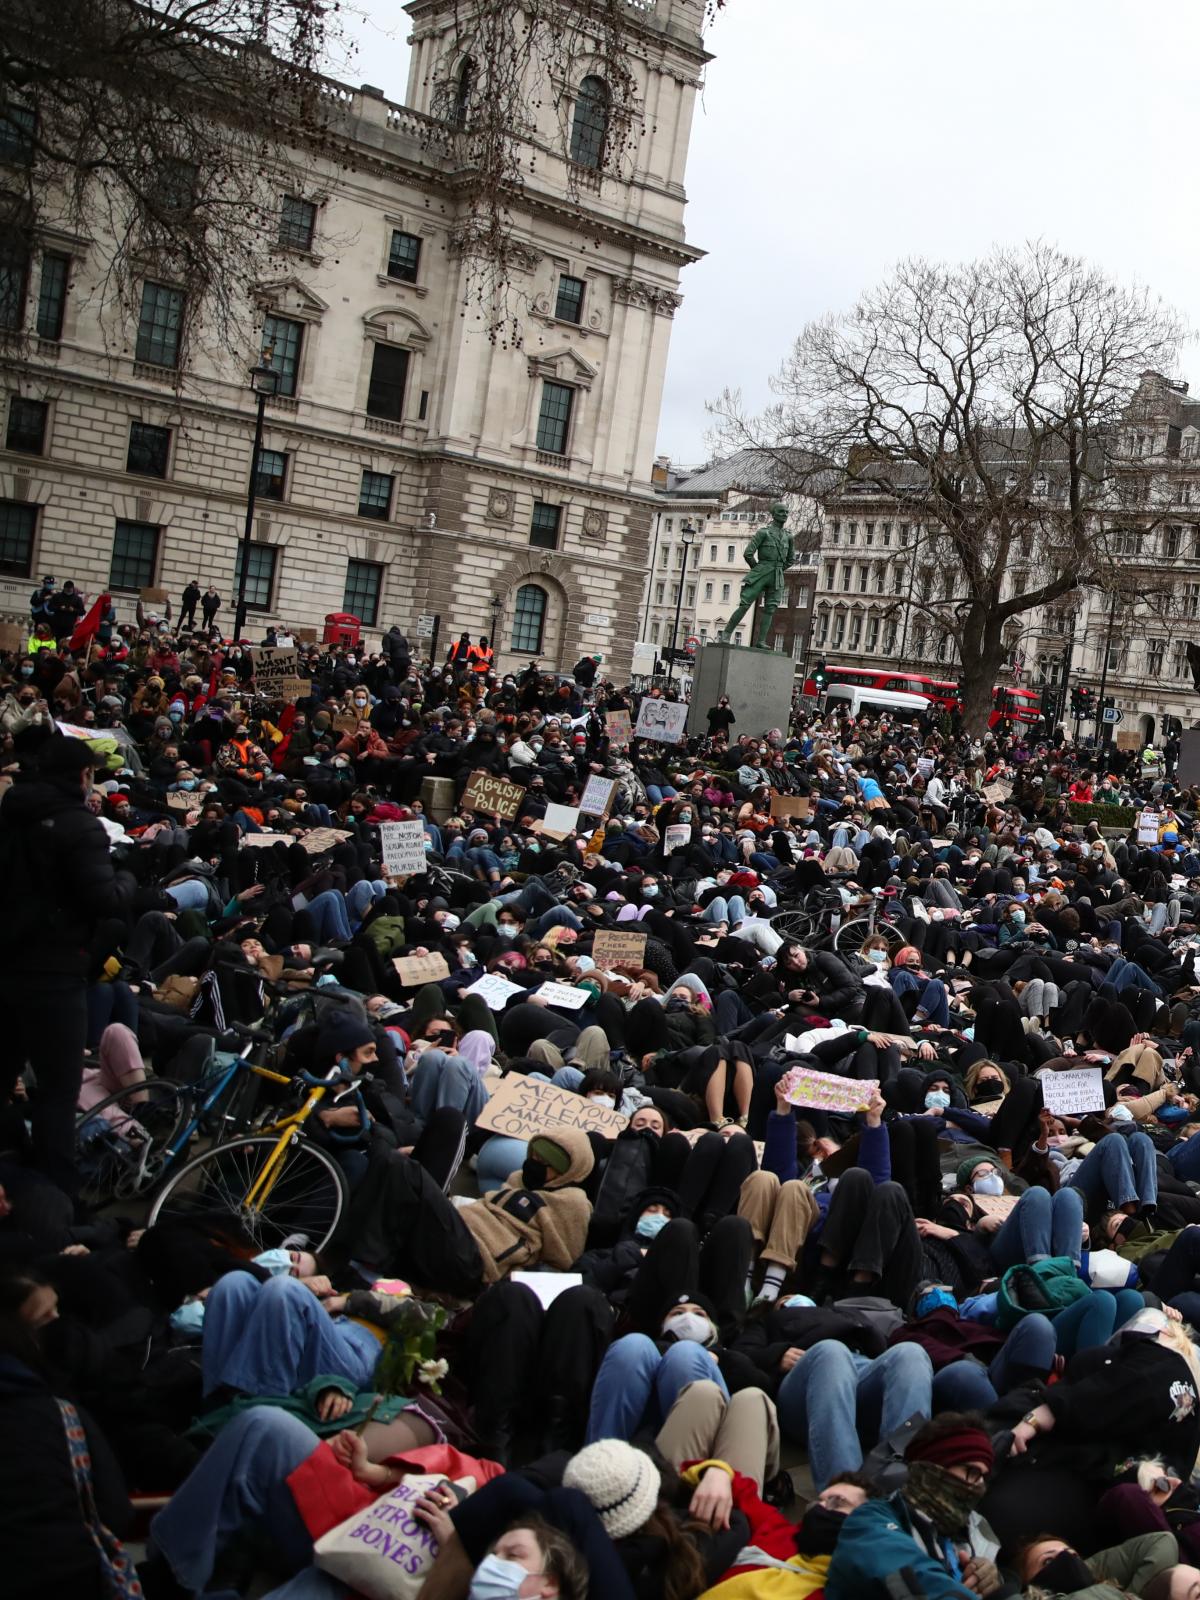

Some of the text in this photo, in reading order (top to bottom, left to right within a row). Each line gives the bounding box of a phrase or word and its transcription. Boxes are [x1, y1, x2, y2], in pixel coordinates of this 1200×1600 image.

[259, 650, 274, 661] IT
[256, 668, 270, 678] MY
[473, 776, 523, 800] ABOLISH
[474, 792, 518, 817] POLICE
[399, 832, 411, 840] NOT
[390, 861, 424, 873] MURDER
[1045, 1073, 1060, 1082] FOR
[510, 1094, 606, 1132] SILENCE
[513, 1080, 627, 1131] MEN YOUR
[349, 1523, 423, 1575] BONES
